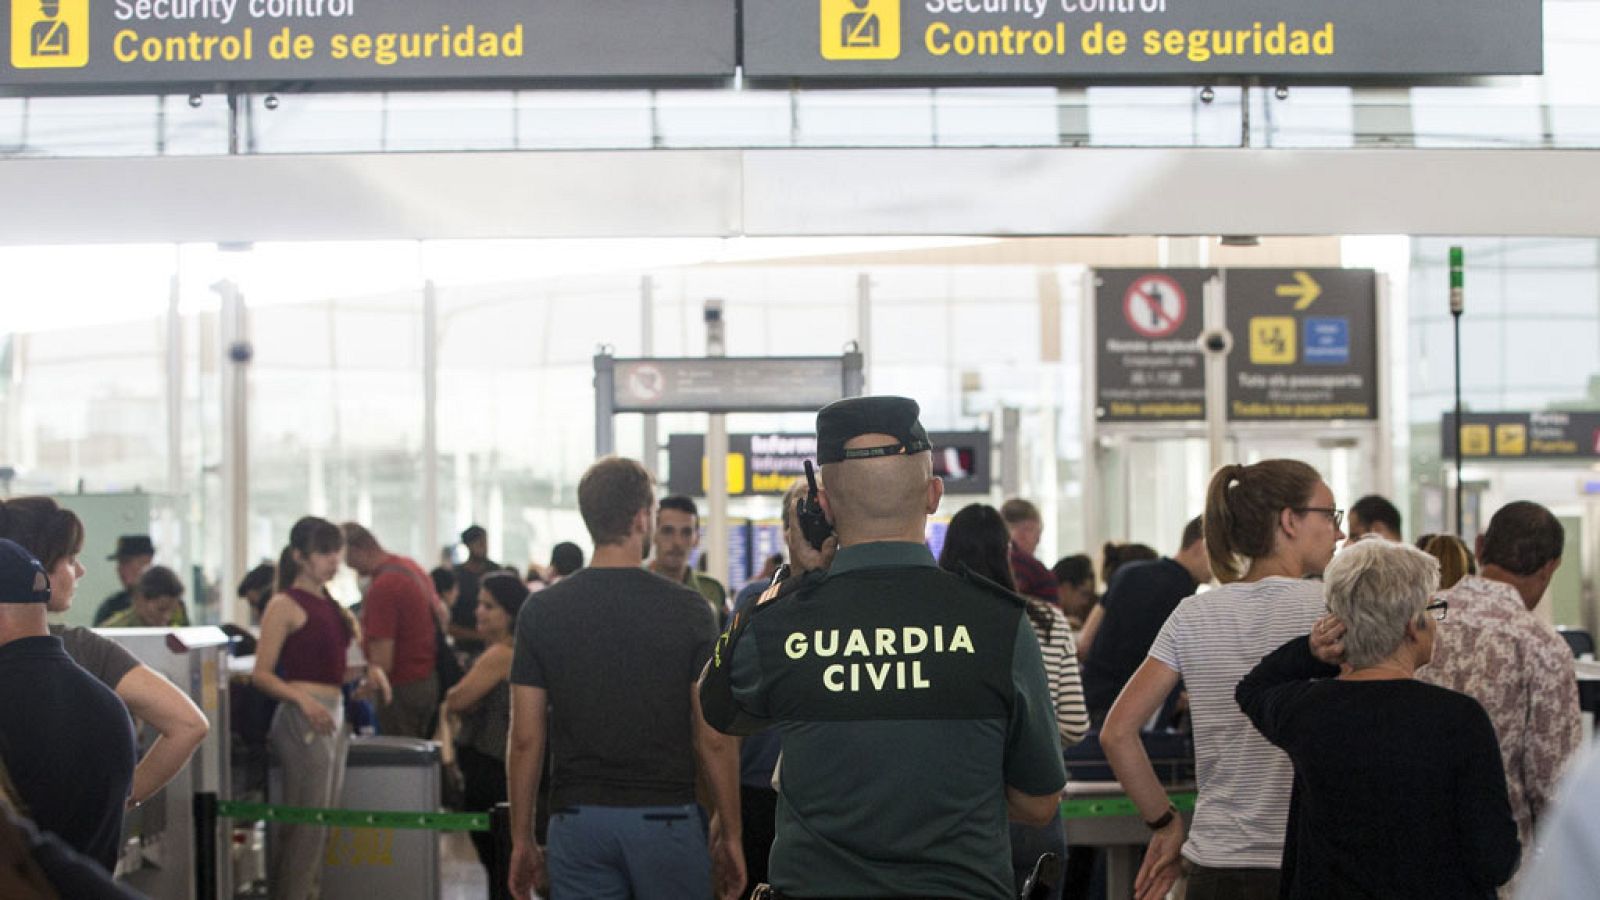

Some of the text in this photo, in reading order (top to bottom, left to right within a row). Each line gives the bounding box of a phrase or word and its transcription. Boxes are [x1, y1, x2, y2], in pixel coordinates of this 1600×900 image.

[114, 0, 354, 25] Security control
[112, 23, 524, 65] Control de seguridad
[924, 21, 1334, 63] Control de seguridad
[784, 625, 975, 660] GUARDIA
[822, 661, 930, 692] CIVIL
